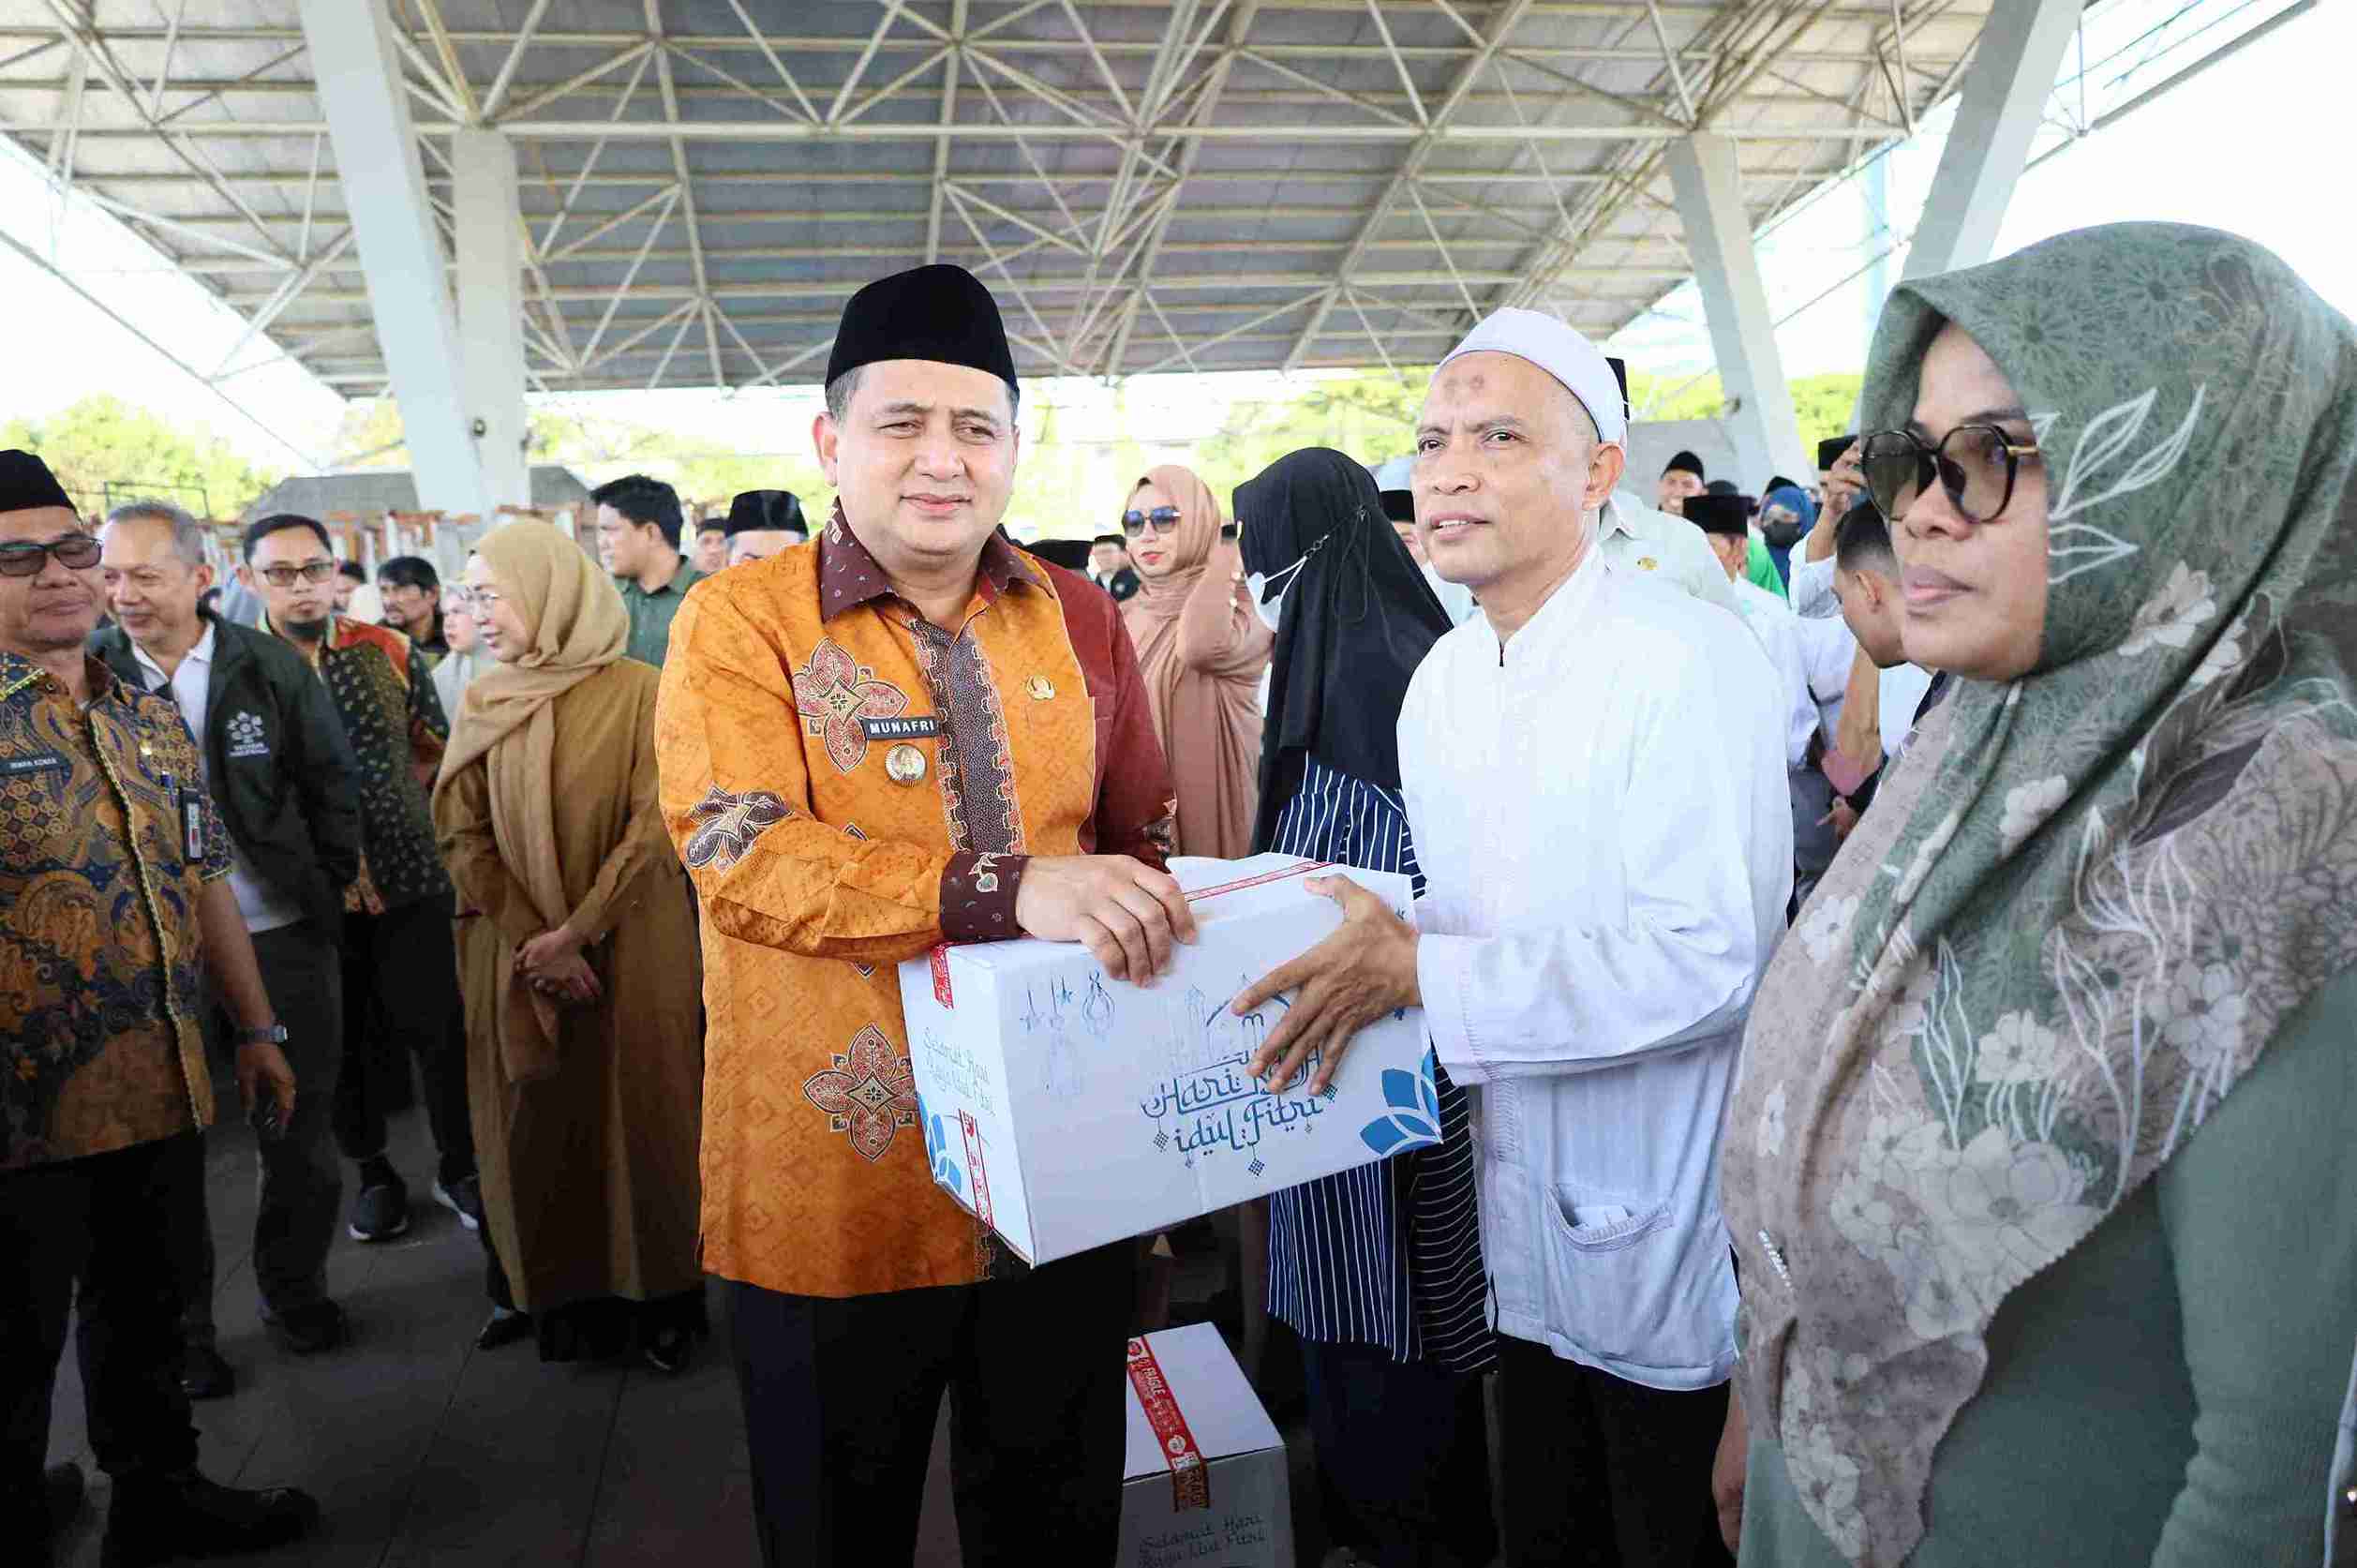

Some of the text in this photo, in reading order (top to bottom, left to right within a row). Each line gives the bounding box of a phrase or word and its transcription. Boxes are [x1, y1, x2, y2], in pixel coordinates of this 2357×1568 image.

[869, 720, 934, 734] MUNAFRI
[1141, 1068, 1244, 1118] Hari
[1243, 1095, 1324, 1145] Fitri
